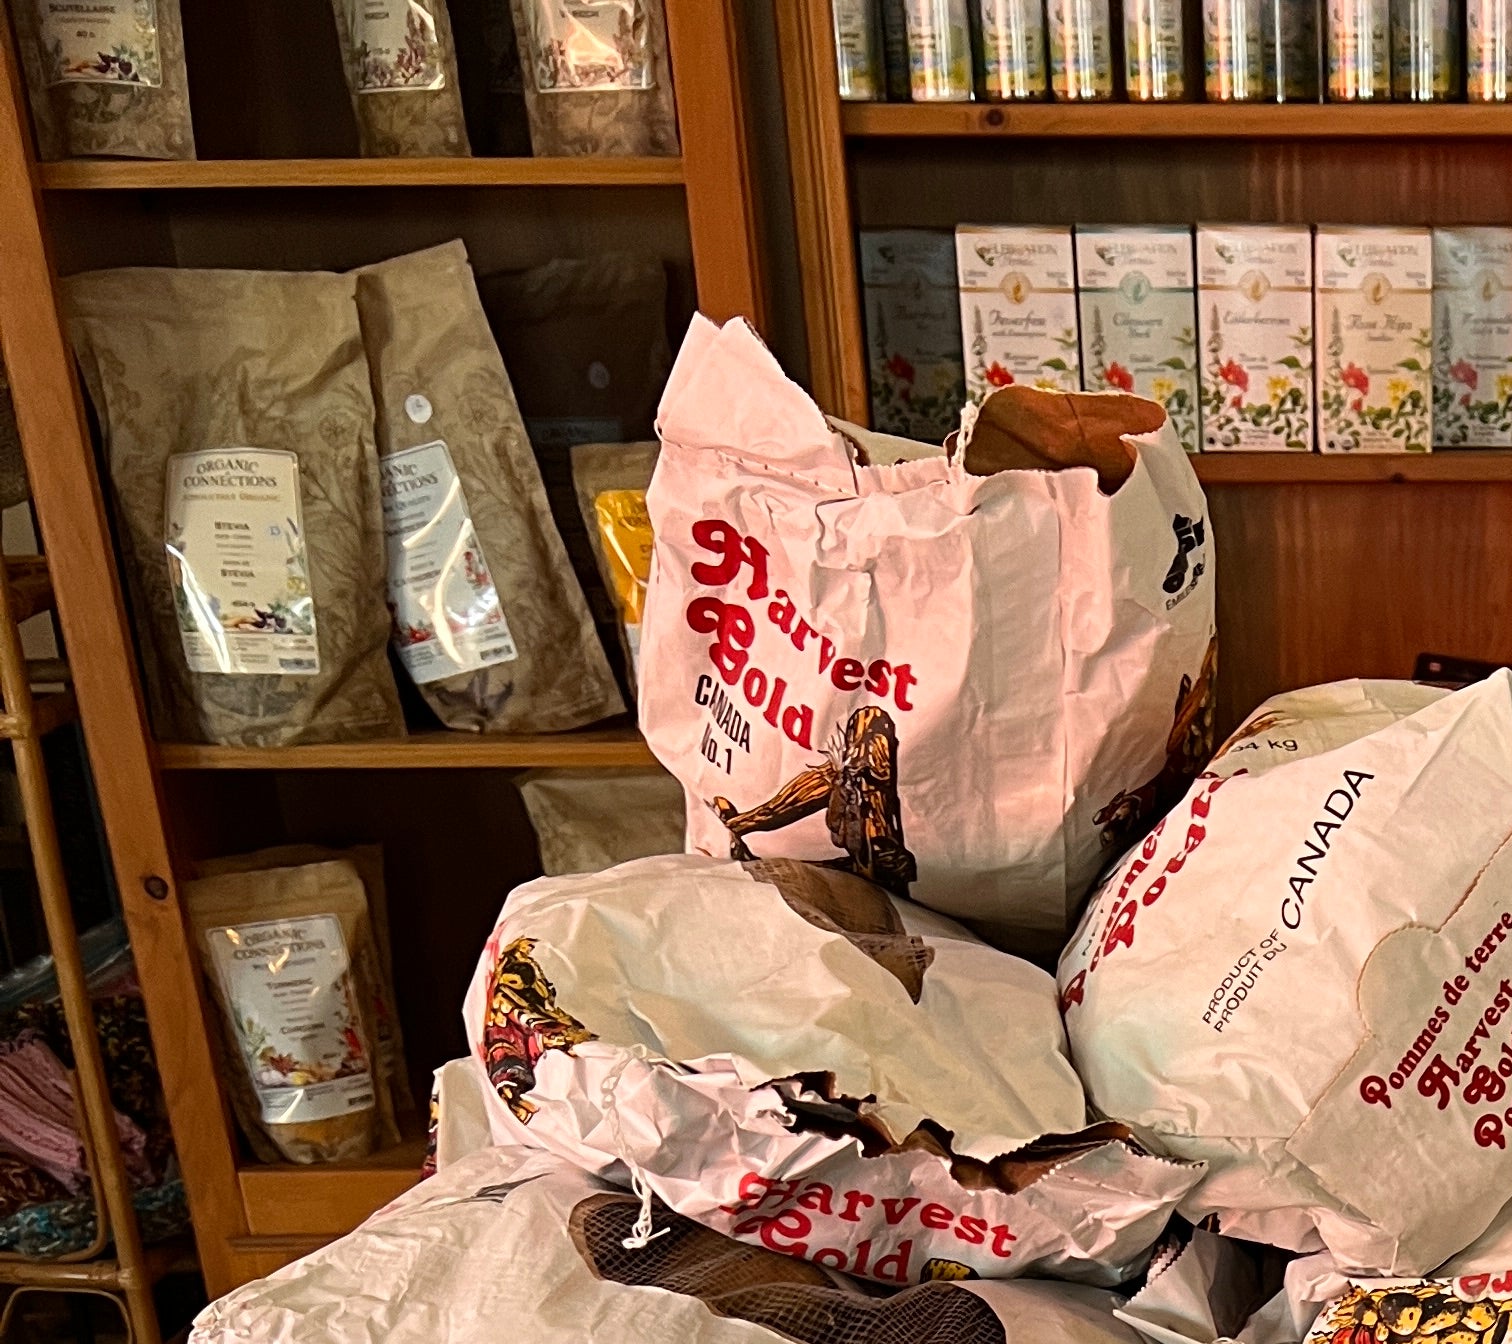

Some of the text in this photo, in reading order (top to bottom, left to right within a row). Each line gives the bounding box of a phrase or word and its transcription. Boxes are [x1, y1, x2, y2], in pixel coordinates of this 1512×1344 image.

[183, 474, 279, 488] CONNECTIONS
[690, 519, 918, 711] Harvest
[686, 596, 814, 751] Gold
[695, 674, 751, 754] CANADA
[1267, 738, 1299, 752] kg
[1280, 768, 1375, 930] CANADA
[1202, 928, 1280, 1026] PRODUCT OF
[1213, 941, 1289, 1033] PRODUIT DU
[1360, 1005, 1449, 1108] Pommes
[1445, 972, 1469, 1006] de
[719, 1171, 1018, 1258] Harvest
[733, 1208, 913, 1283] Gold
